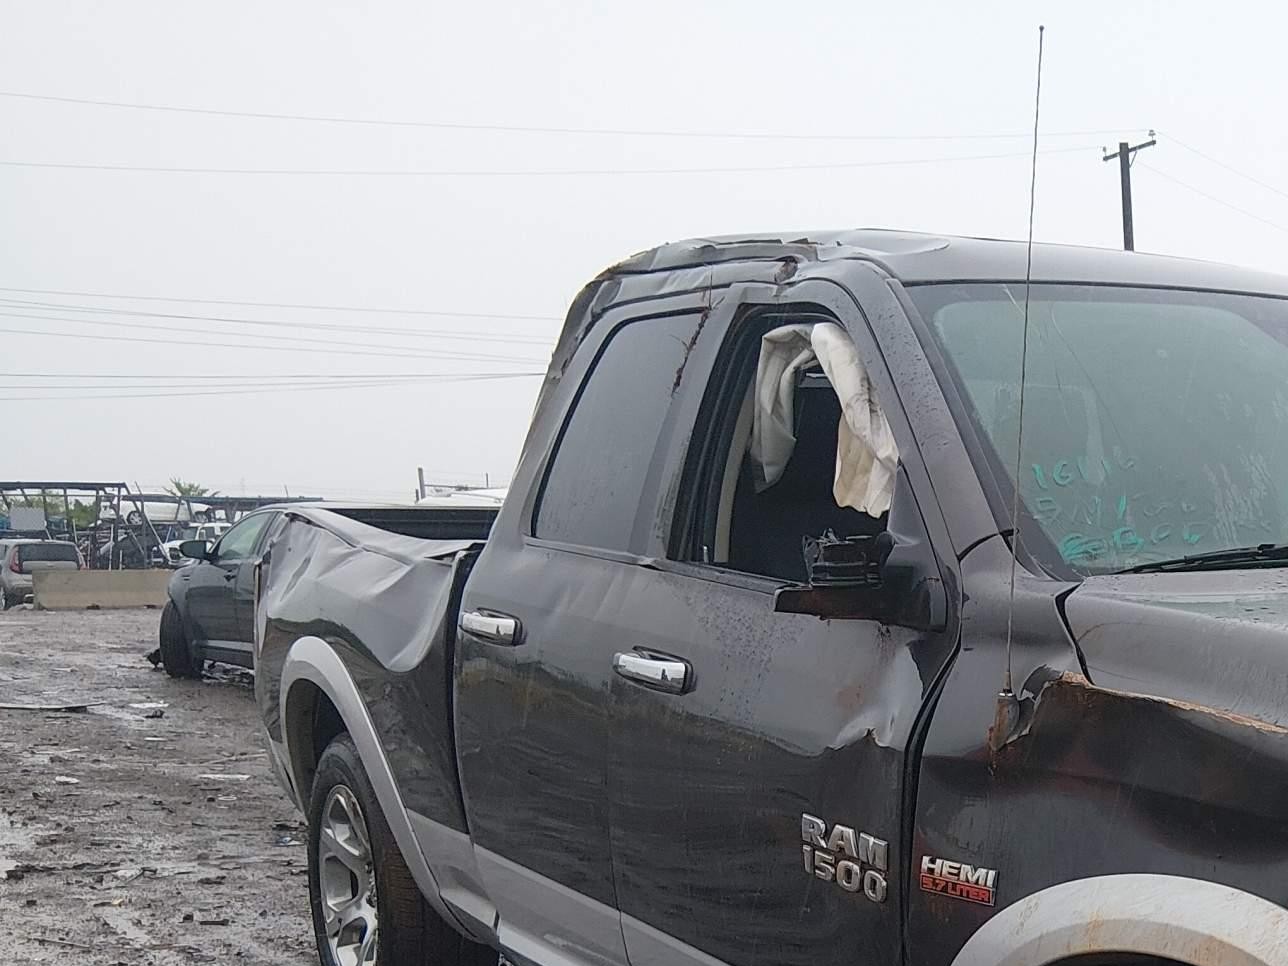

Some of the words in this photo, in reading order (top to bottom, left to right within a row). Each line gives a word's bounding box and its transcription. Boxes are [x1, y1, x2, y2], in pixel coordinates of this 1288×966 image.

[802, 812, 888, 870] RAM
[802, 844, 887, 903] 1500
[921, 855, 997, 888] HEMI
[922, 876, 946, 891] 5.7
[947, 882, 990, 902] LITER
